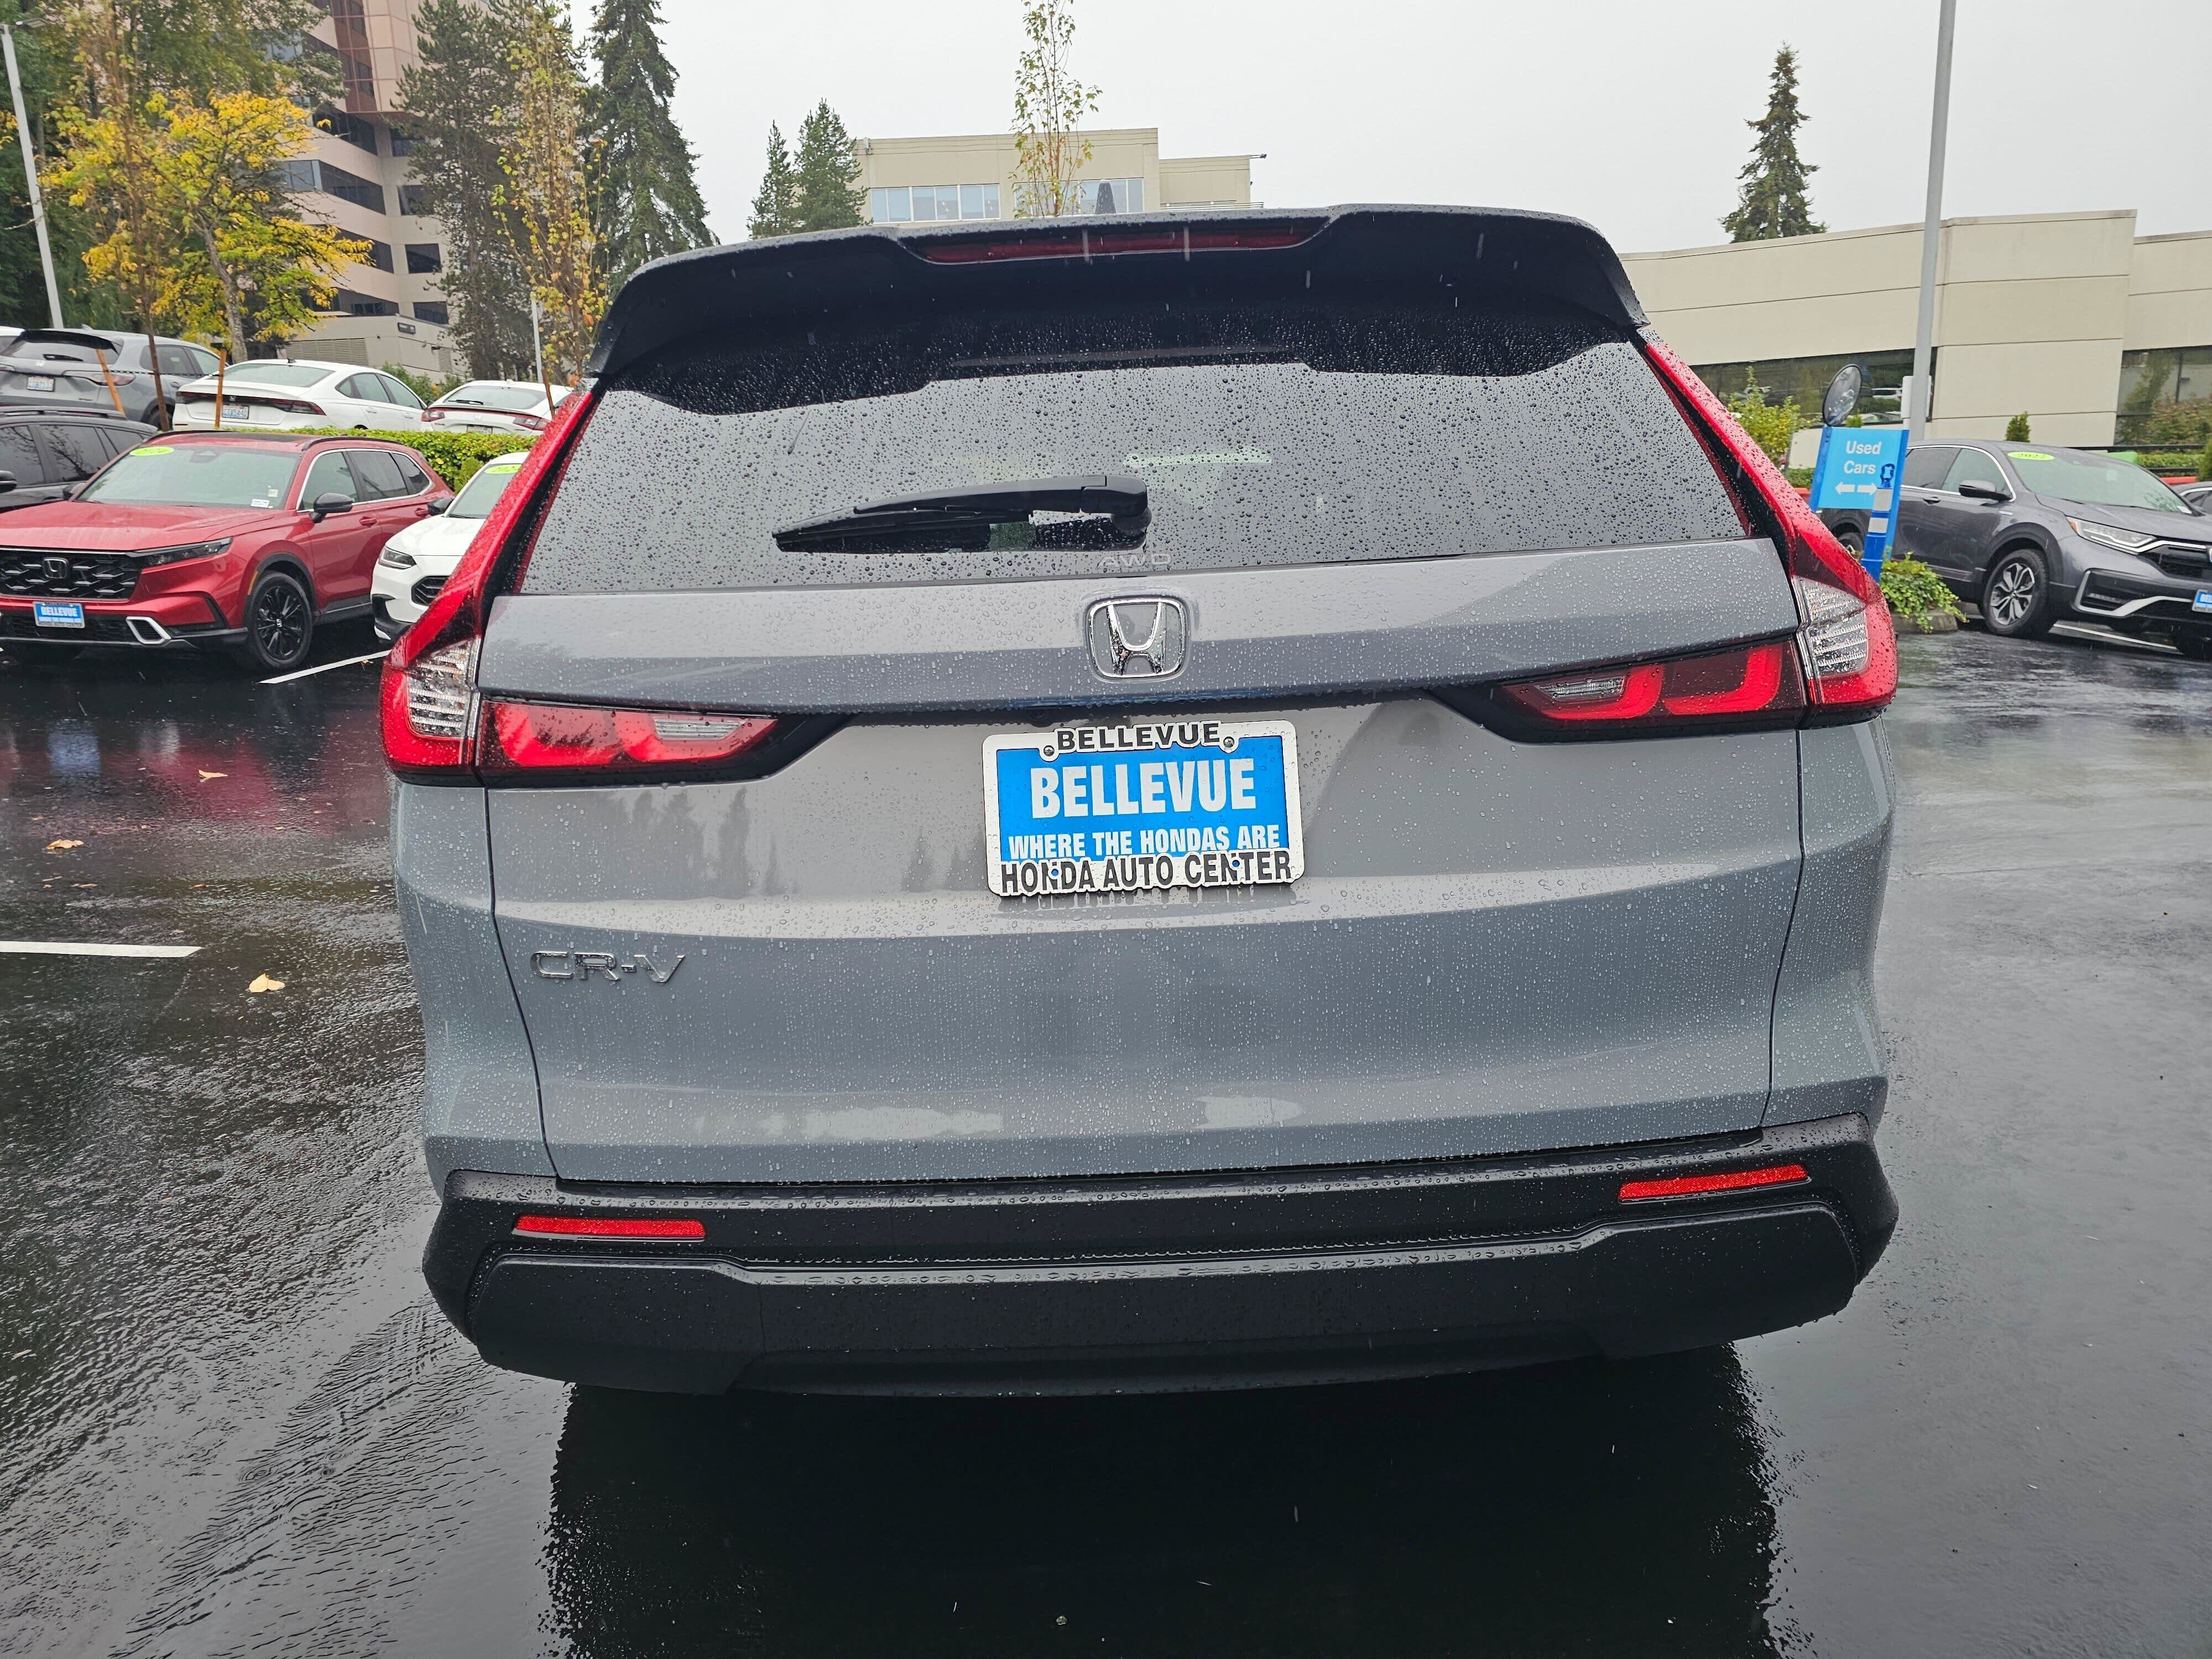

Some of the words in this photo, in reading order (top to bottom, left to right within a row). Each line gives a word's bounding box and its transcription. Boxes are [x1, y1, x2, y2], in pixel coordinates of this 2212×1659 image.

[1846, 441, 1882, 455] Used
[1844, 460, 1876, 474] Cars
[1097, 554, 1172, 568] AWD
[1056, 722, 1220, 750] BELLEVUE
[1030, 758, 1256, 819] BELLEVUE
[1009, 832, 1085, 859] WHERE
[1092, 831, 1133, 856] THE
[1140, 827, 1231, 854] HONDAS
[1237, 825, 1280, 849] ARE
[1000, 861, 1096, 893] HONDA
[1103, 855, 1175, 889] AUTO
[1185, 851, 1291, 884] CENTER
[530, 950, 686, 983] CR-V
